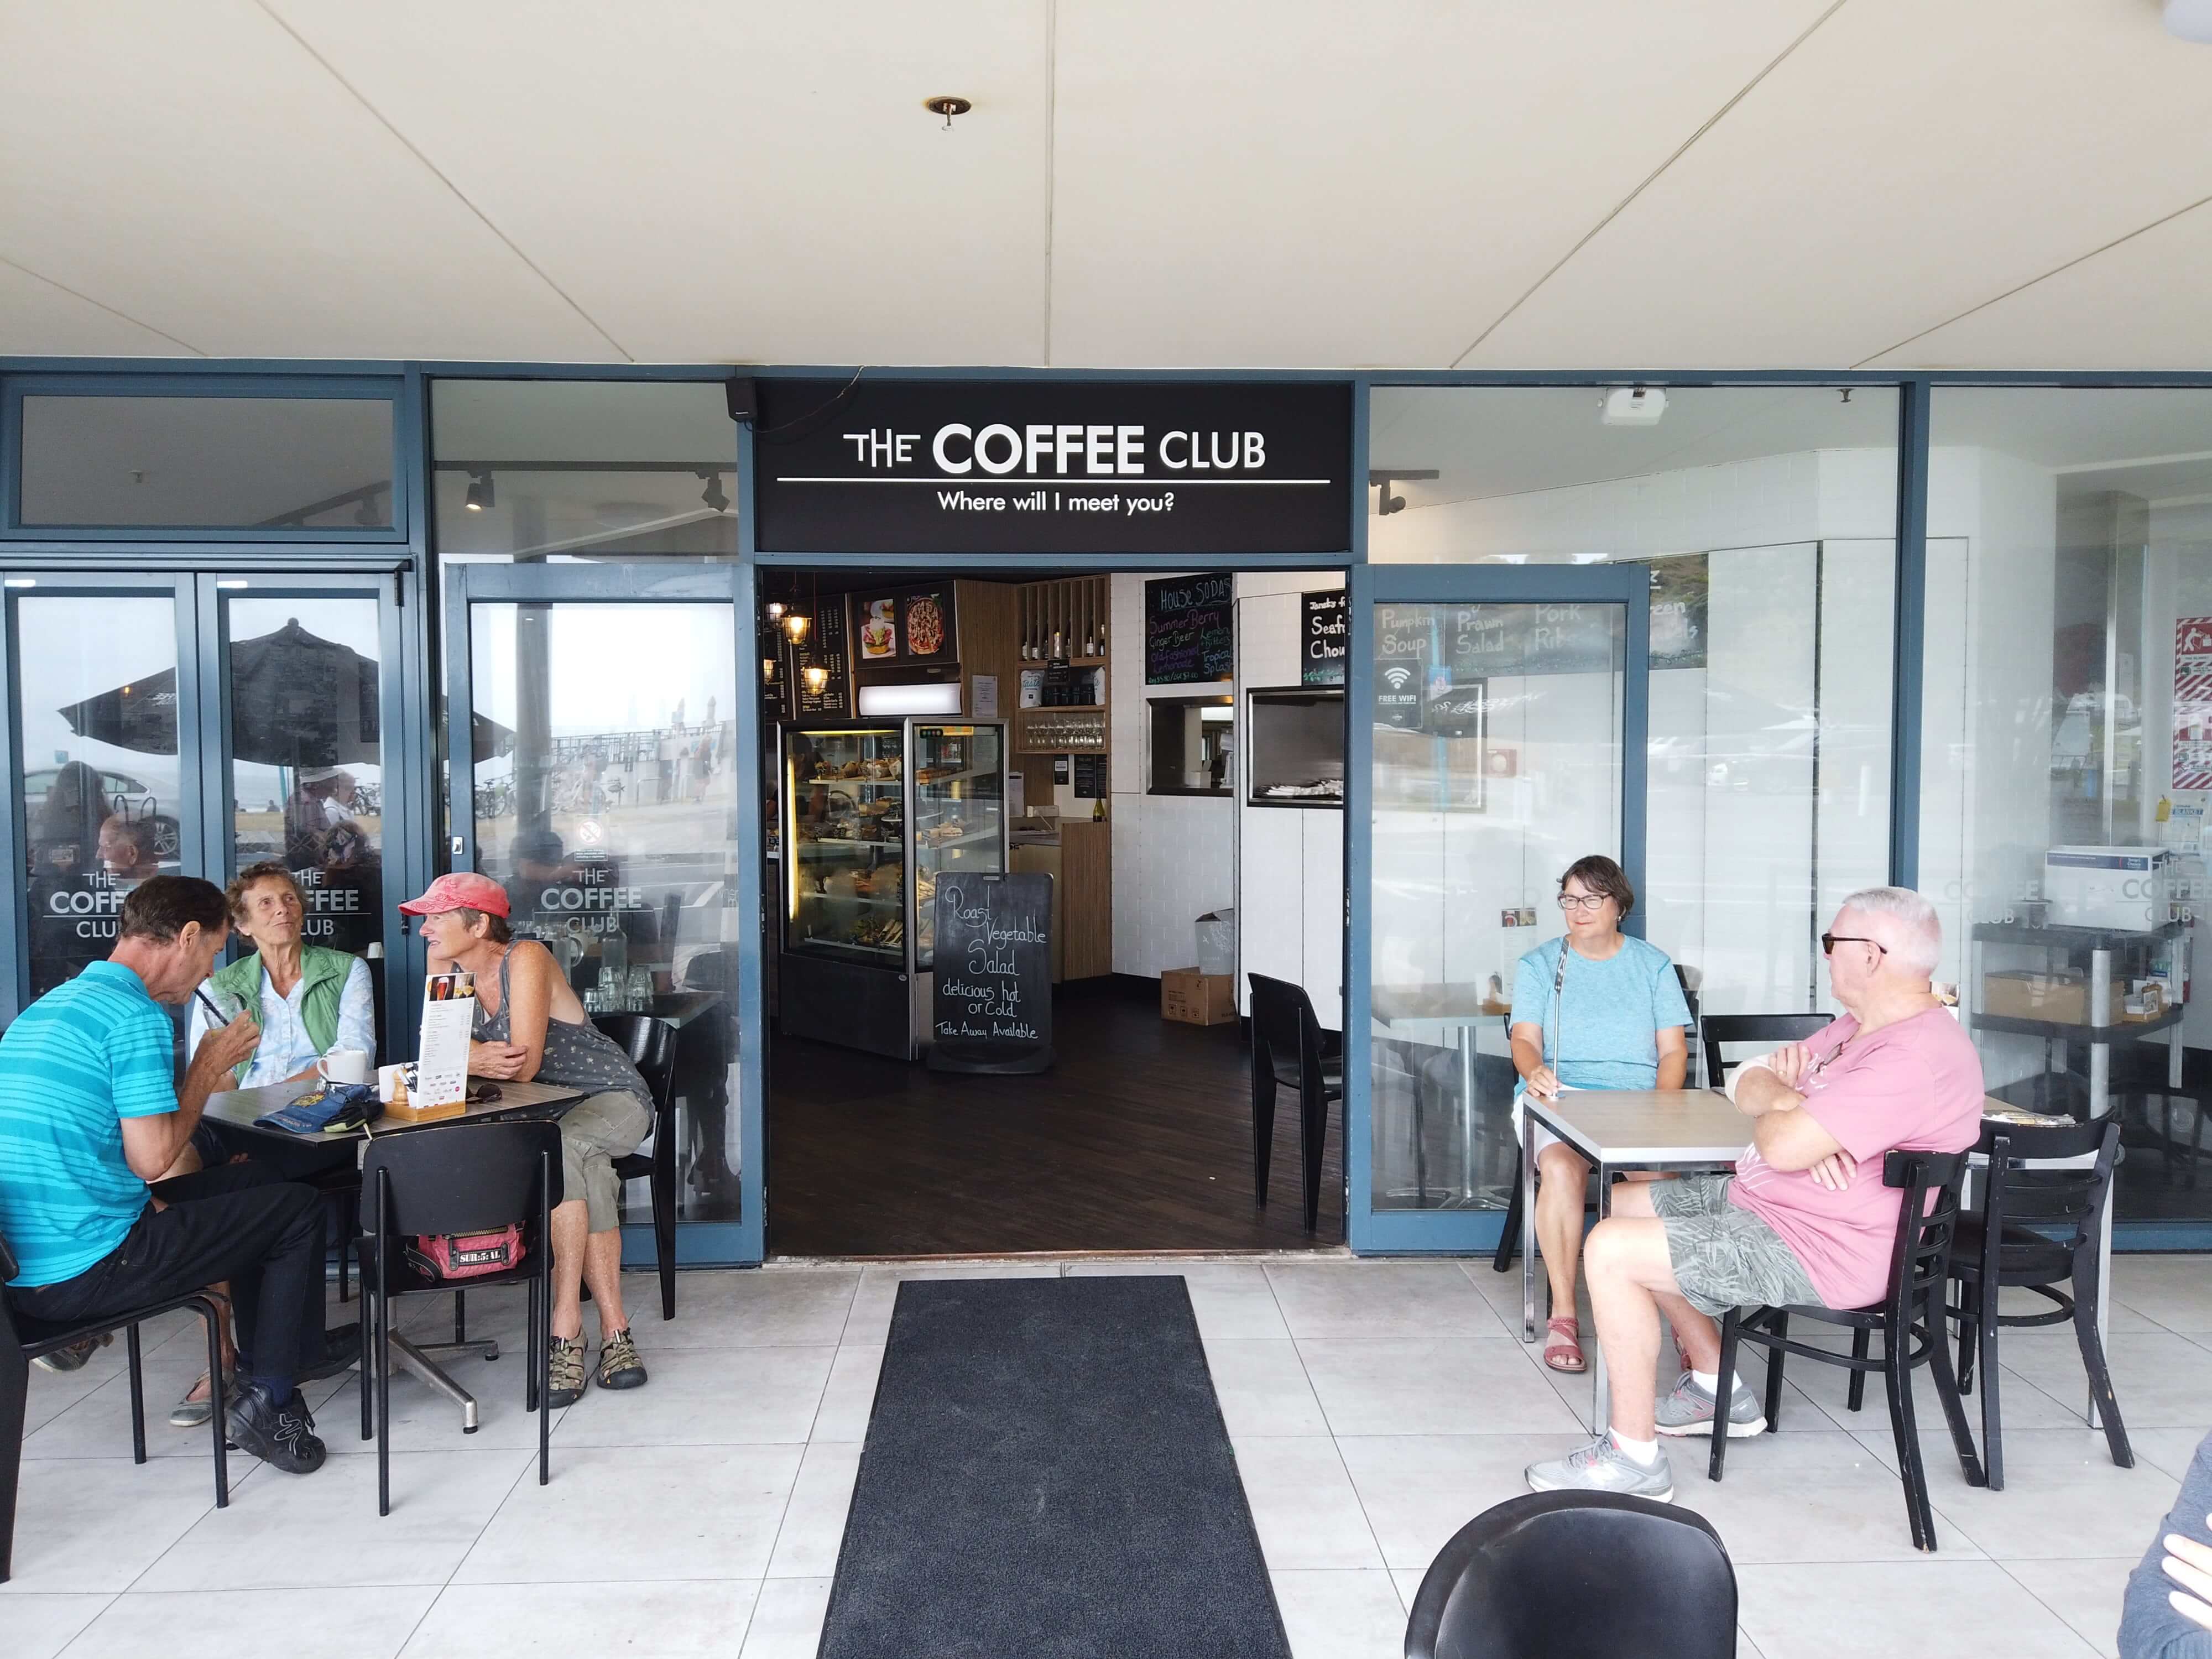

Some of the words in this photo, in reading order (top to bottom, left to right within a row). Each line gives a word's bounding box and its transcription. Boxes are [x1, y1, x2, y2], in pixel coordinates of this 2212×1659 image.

[843, 429, 921, 468] THE
[932, 423, 1144, 474] COFFEE
[1159, 431, 1265, 469] CLUB
[937, 491, 1006, 512] Where
[1013, 492, 1046, 511] will
[1055, 493, 1060, 511] I
[1068, 494, 1120, 512] meet
[1125, 493, 1175, 515] you?
[1150, 615, 1188, 635] Summer
[1187, 609, 1221, 629] Berry
[1382, 608, 1435, 633] Pumpkin
[1456, 612, 1504, 632] Prawn
[1150, 636, 1173, 651] Ginger
[1172, 630, 1196, 647] Beer
[1382, 634, 1427, 658] Soup
[1456, 634, 1504, 655] Salad
[82, 871, 121, 888] THE
[572, 868, 609, 885] THE
[49, 891, 128, 914] COFF
[541, 888, 642, 910] COFFEE
[945, 885, 992, 928] Roast
[76, 921, 117, 938] CLU
[567, 916, 618, 933] CLUB
[986, 909, 1047, 950] Vegetable
[968, 939, 1020, 976] Salad
[942, 978, 995, 1001] delicious
[1002, 980, 1021, 1003] hot
[968, 1002, 983, 1015] or
[985, 1001, 1017, 1018] Cold
[935, 1020, 959, 1036] Take
[961, 1021, 988, 1040] Away
[993, 1021, 1039, 1040] Available
